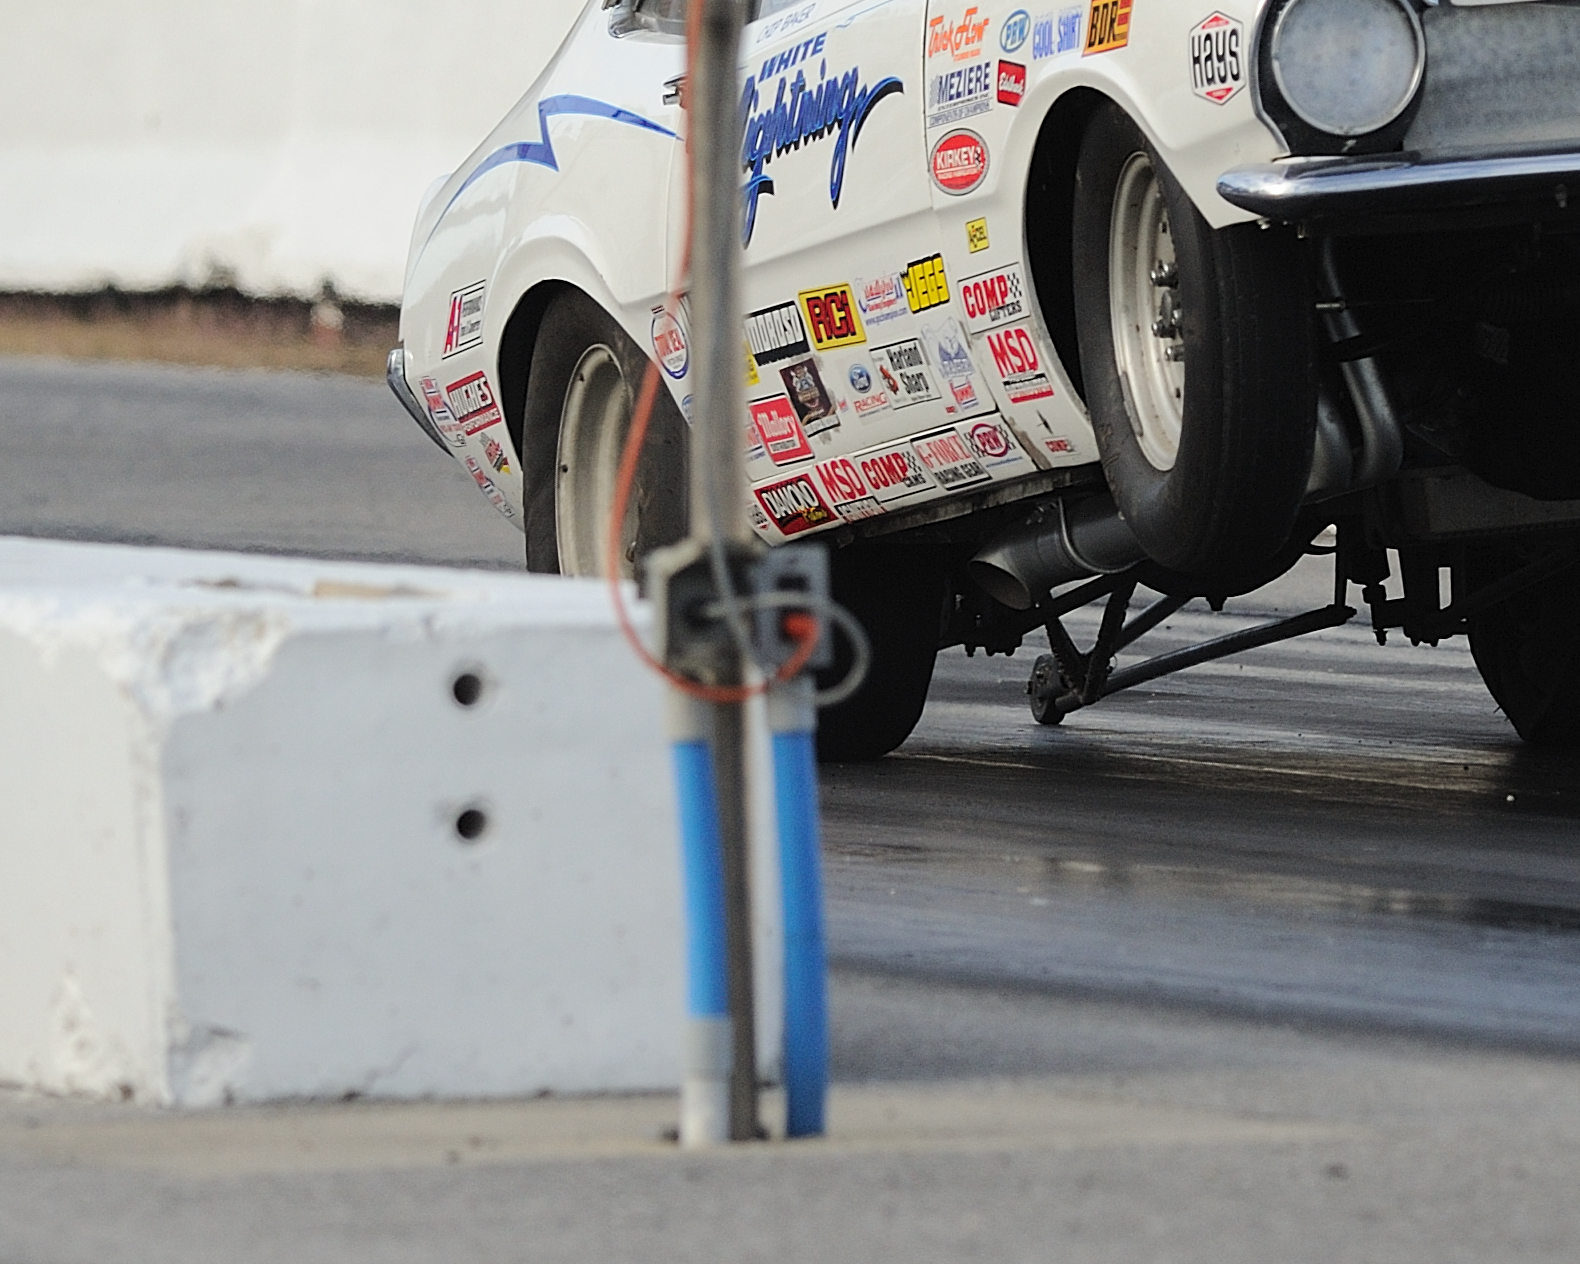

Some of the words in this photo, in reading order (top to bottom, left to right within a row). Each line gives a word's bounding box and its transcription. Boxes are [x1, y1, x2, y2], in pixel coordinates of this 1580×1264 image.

[758, 31, 828, 84] WHITE
[937, 62, 991, 104] MEZIERE
[936, 145, 976, 170] KIRKEY
[906, 253, 950, 314] JEGS
[962, 274, 1009, 319] COMP
[988, 300, 1023, 322] LIFTERS
[987, 328, 1039, 378] MSD
[816, 458, 867, 504] MSD
[861, 452, 909, 490] COMP
[762, 480, 820, 519] DIAMOND
